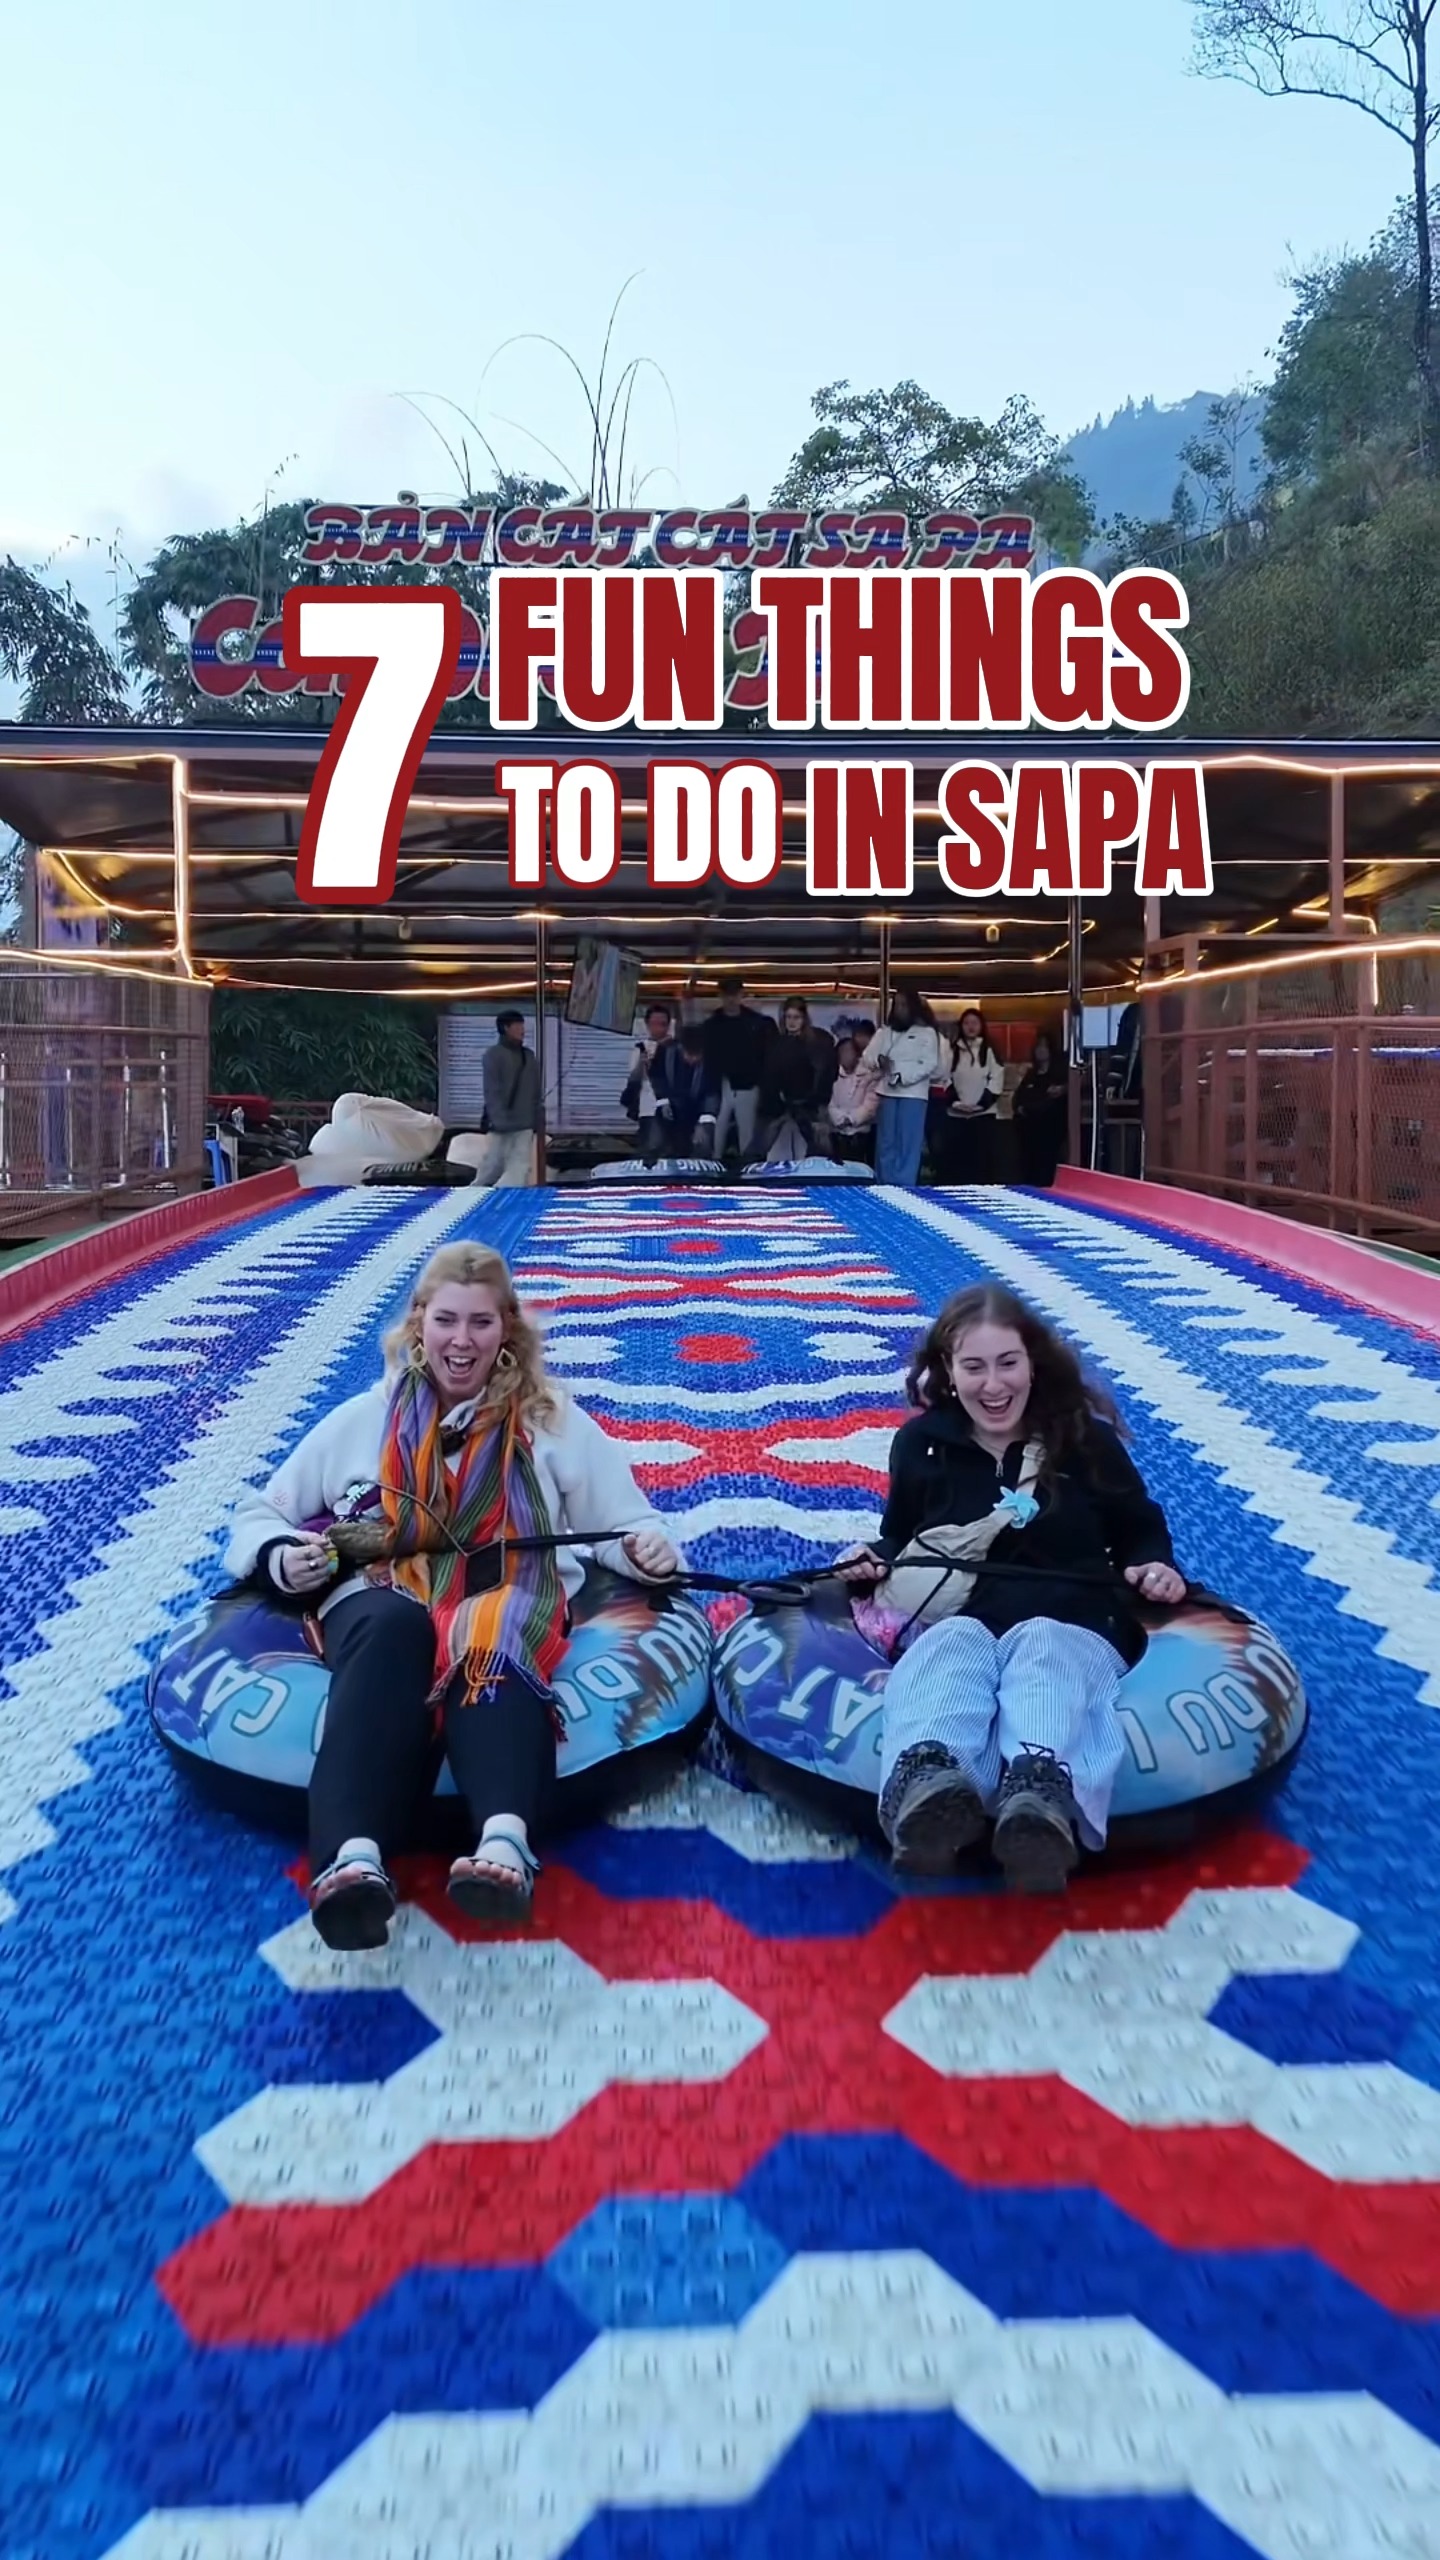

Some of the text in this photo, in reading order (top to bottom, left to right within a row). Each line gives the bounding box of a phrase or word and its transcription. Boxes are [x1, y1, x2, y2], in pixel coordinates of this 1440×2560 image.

[300, 490, 1036, 569] BẢN CÁT CÁT SA PA
[171, 1647, 291, 1738] CÁT
[1166, 1671, 1269, 1756] DU
